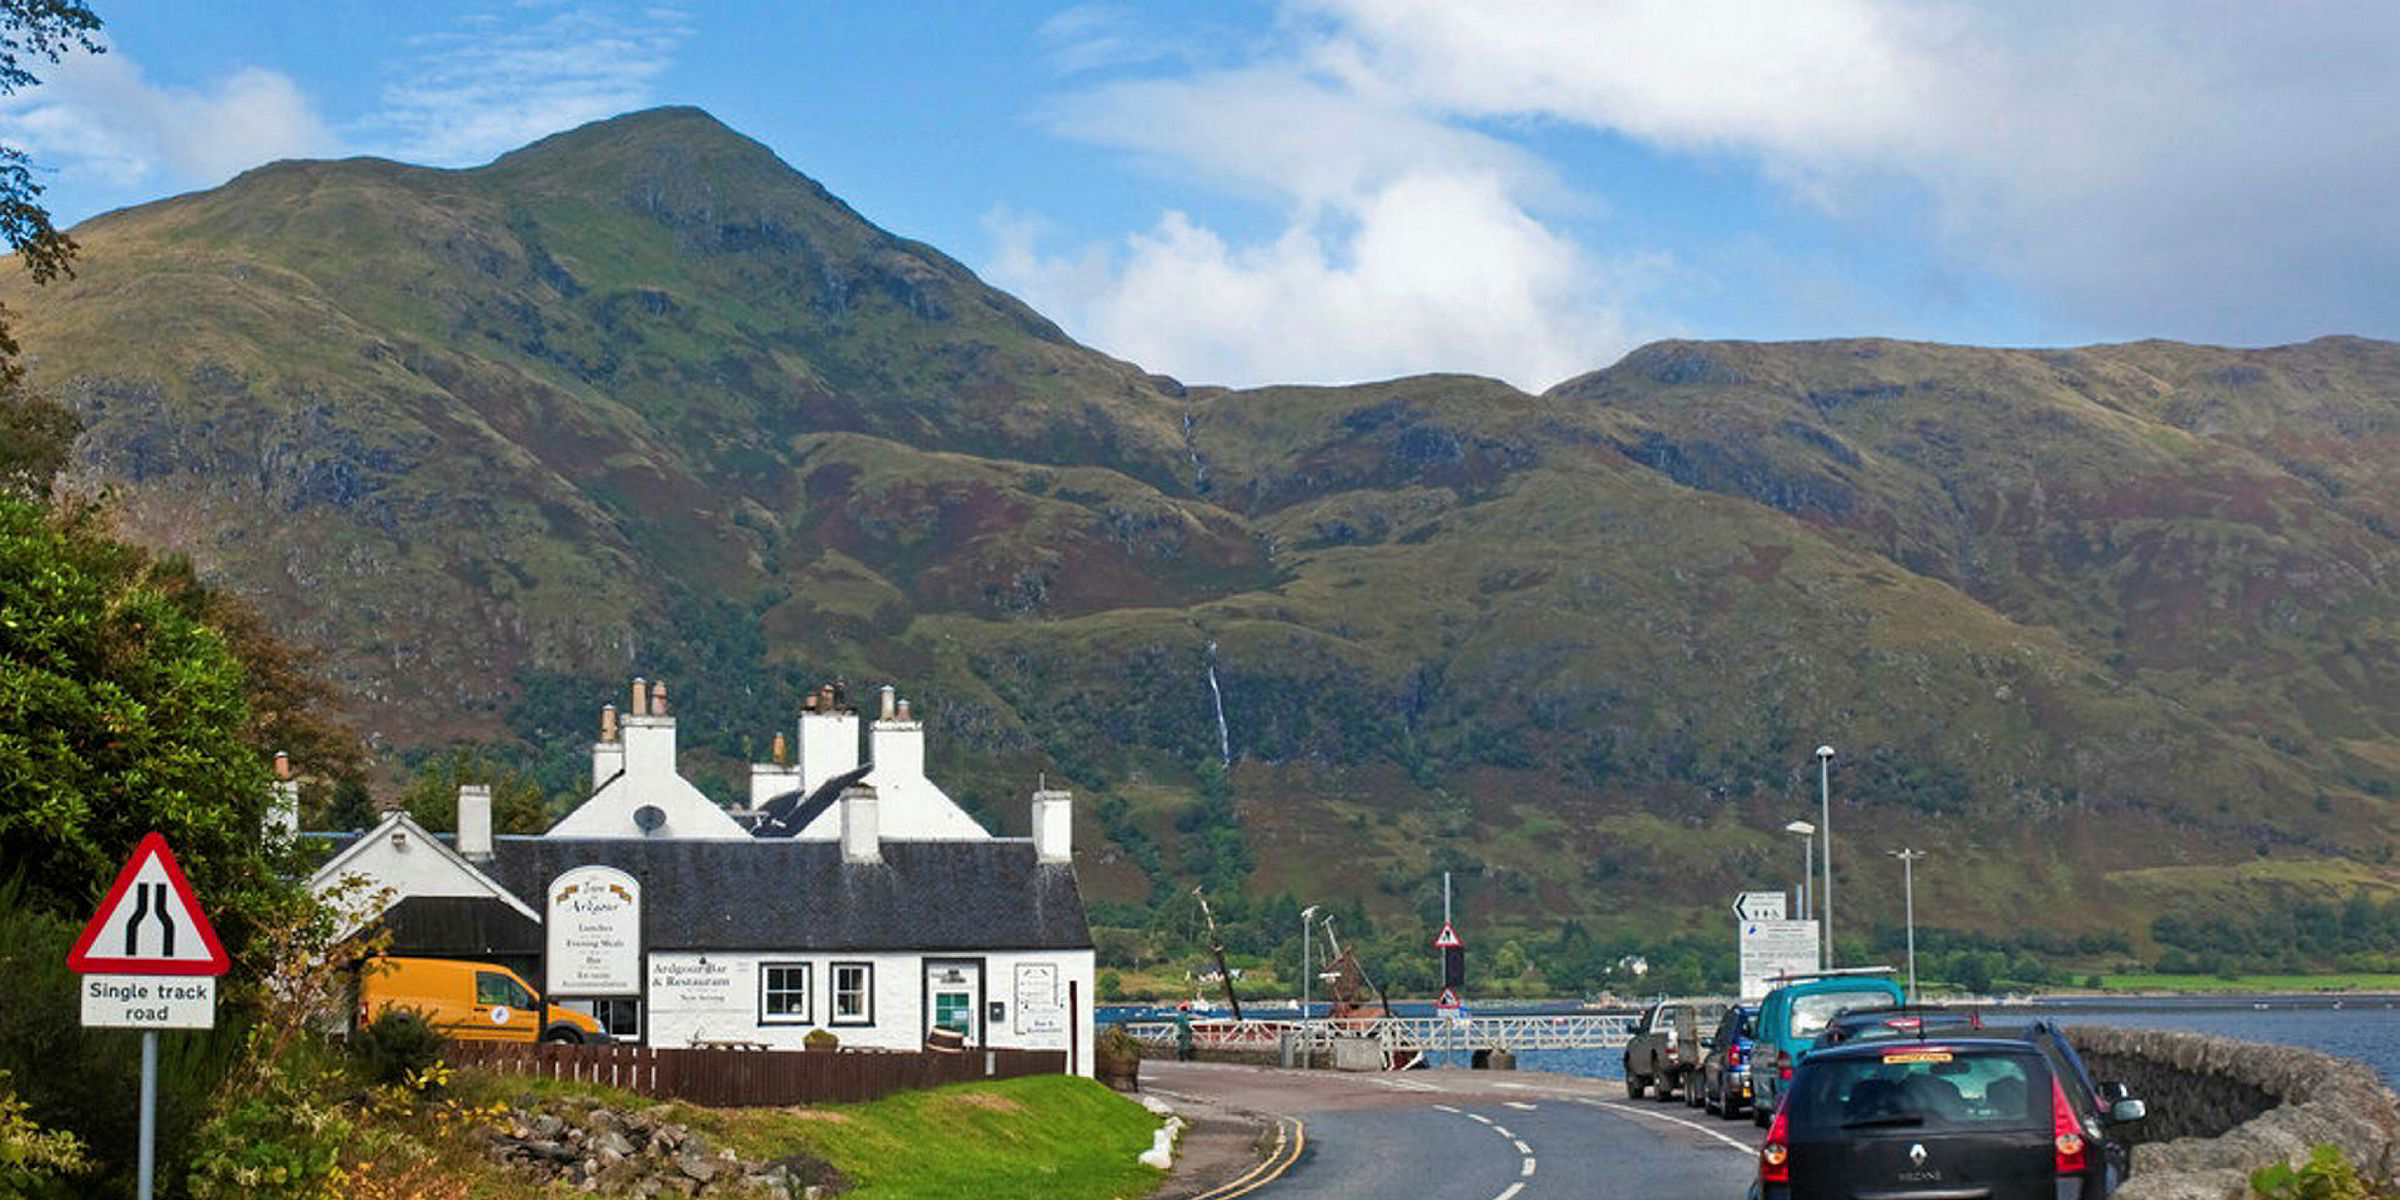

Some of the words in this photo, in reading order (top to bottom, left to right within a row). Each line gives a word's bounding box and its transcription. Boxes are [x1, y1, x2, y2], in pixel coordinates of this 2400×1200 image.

[567, 940, 598, 948] Evening
[654, 963, 703, 975] Ardgour
[705, 963, 727, 974] Bar
[666, 976, 730, 986] Restaurant
[90, 982, 148, 1001] Single
[158, 984, 207, 999] track
[126, 1006, 168, 1020] road
